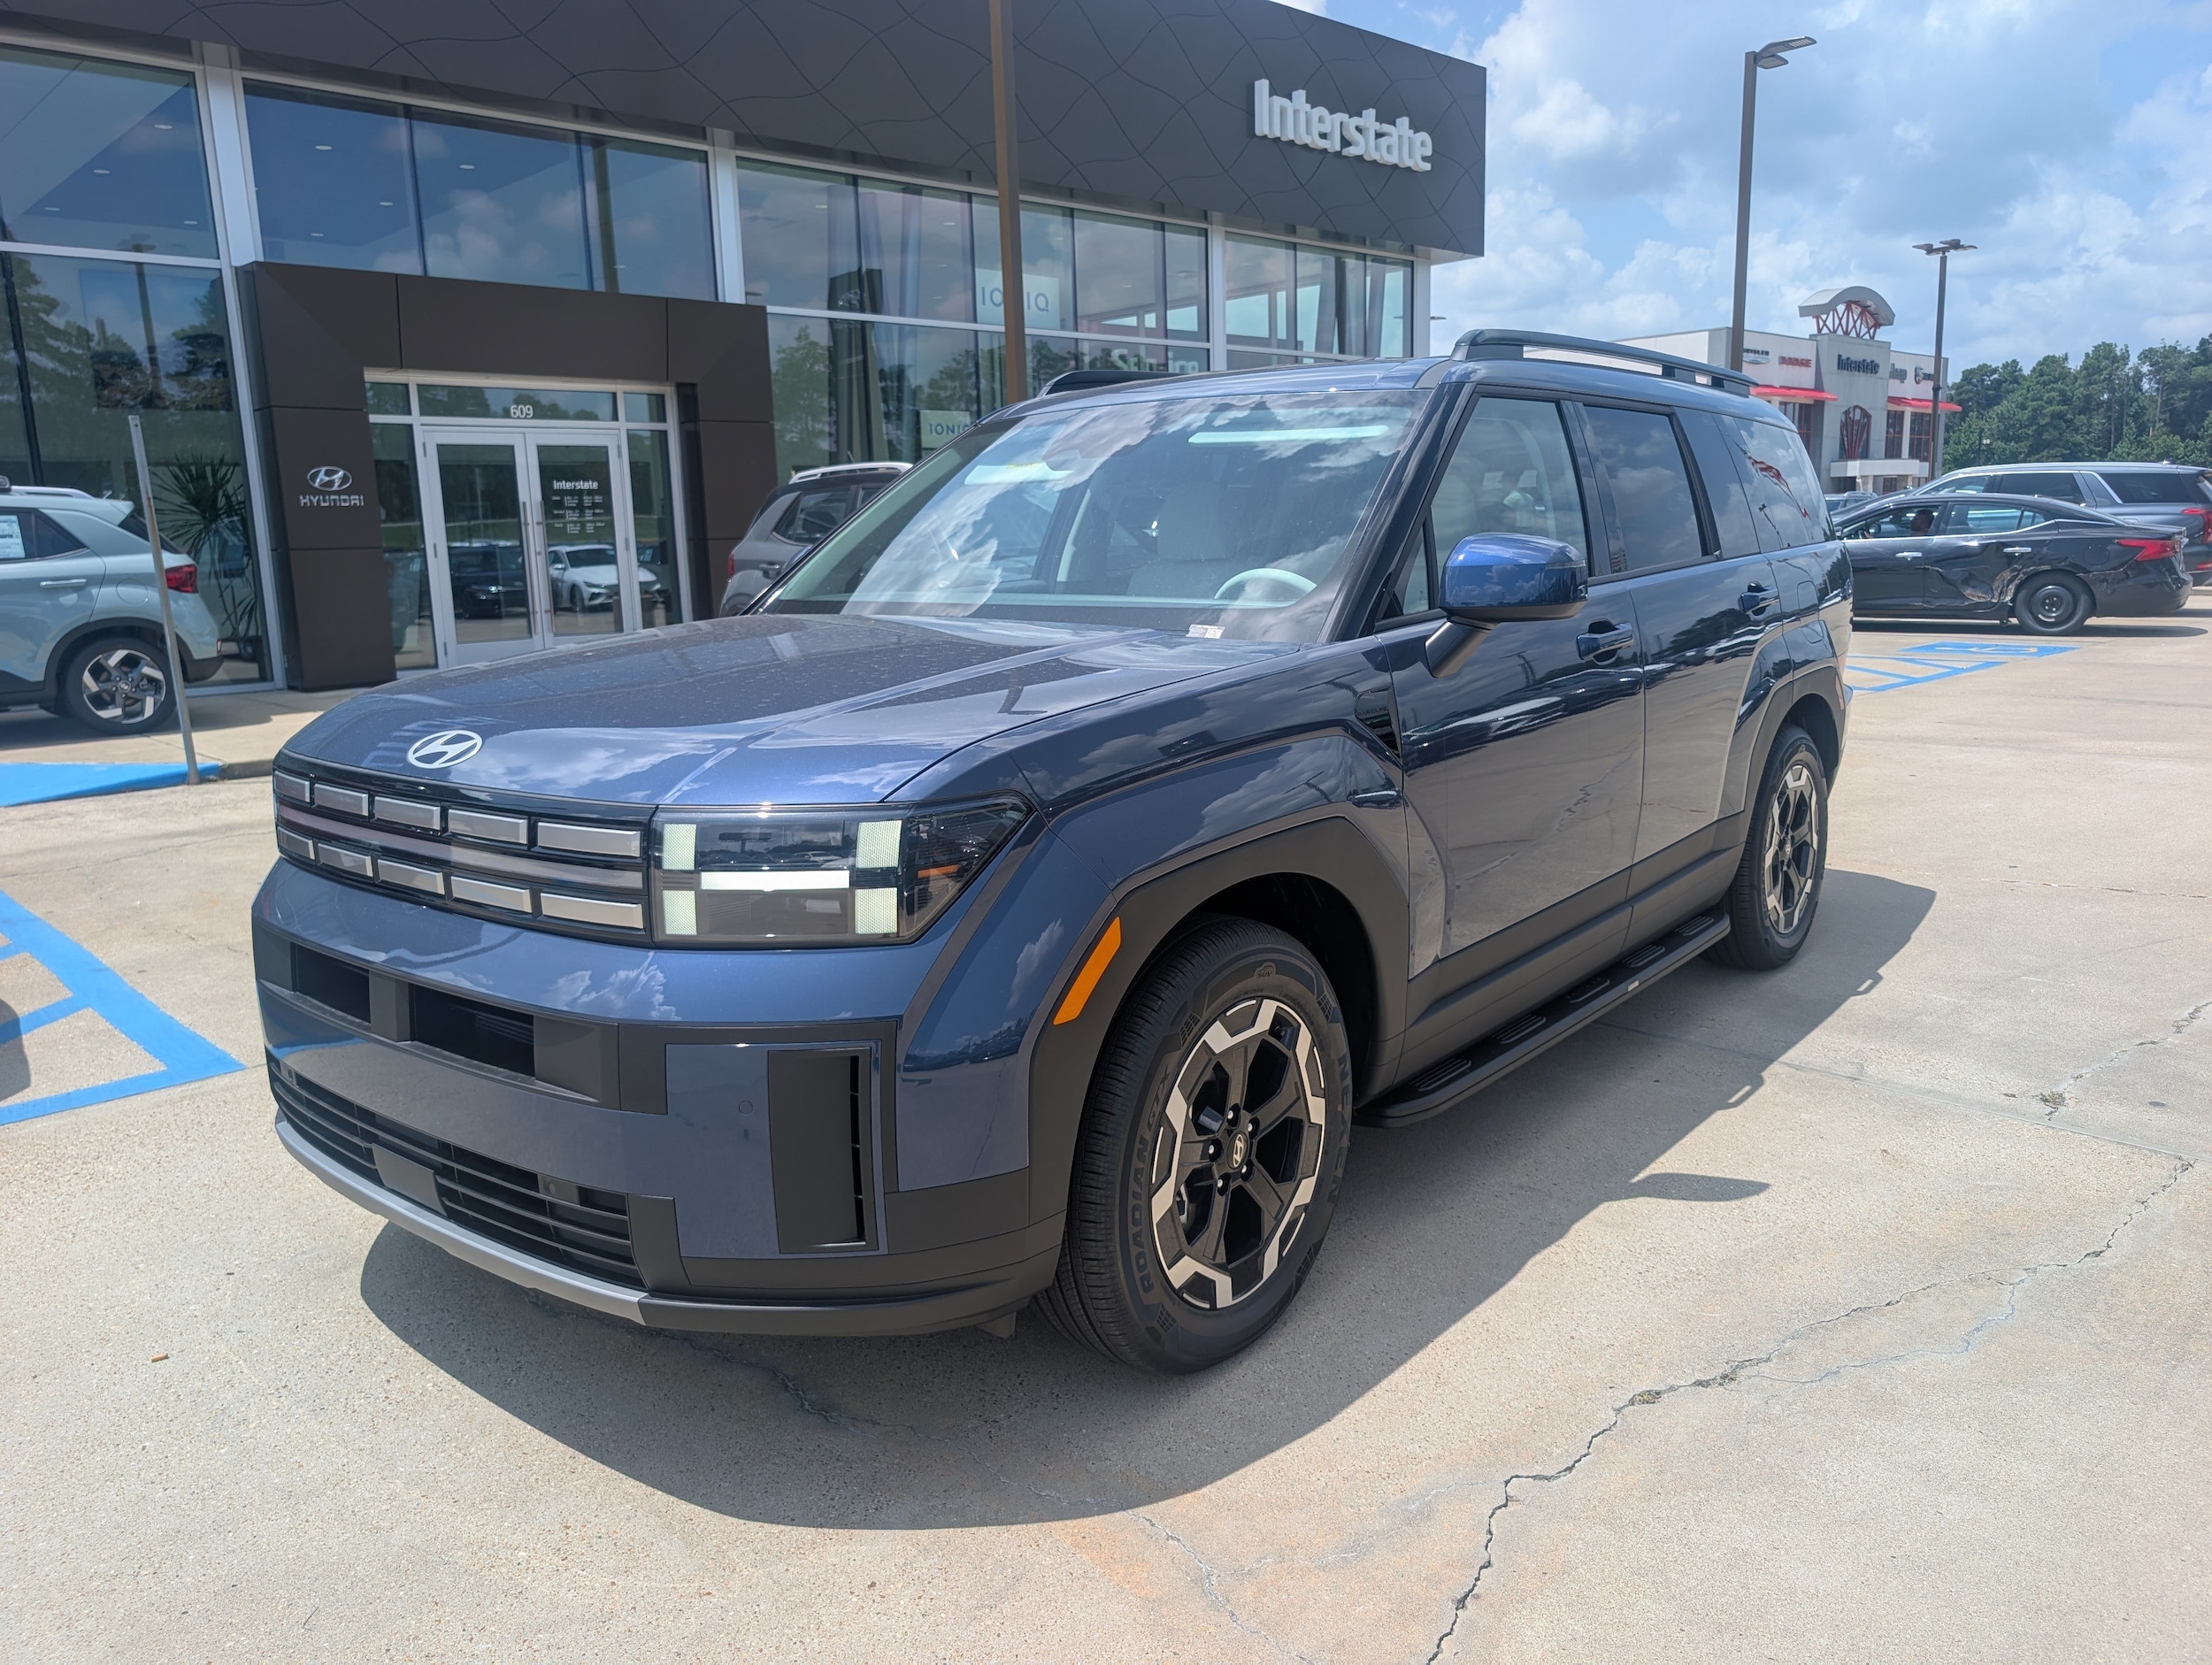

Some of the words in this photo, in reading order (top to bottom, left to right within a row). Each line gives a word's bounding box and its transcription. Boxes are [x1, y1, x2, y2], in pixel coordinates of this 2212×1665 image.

[1254, 78, 1433, 173] Interstate
[981, 287, 1049, 312] IOIQ
[1837, 353, 1880, 375] Interstate
[511, 403, 534, 418] 609
[553, 480, 599, 490] Interstate
[299, 495, 365, 507] HYUNDAI
[1327, 1053, 1353, 1205] NEXEN
[1130, 1134, 1155, 1295] ROADIAN
[1147, 1063, 1171, 1133] GTX
